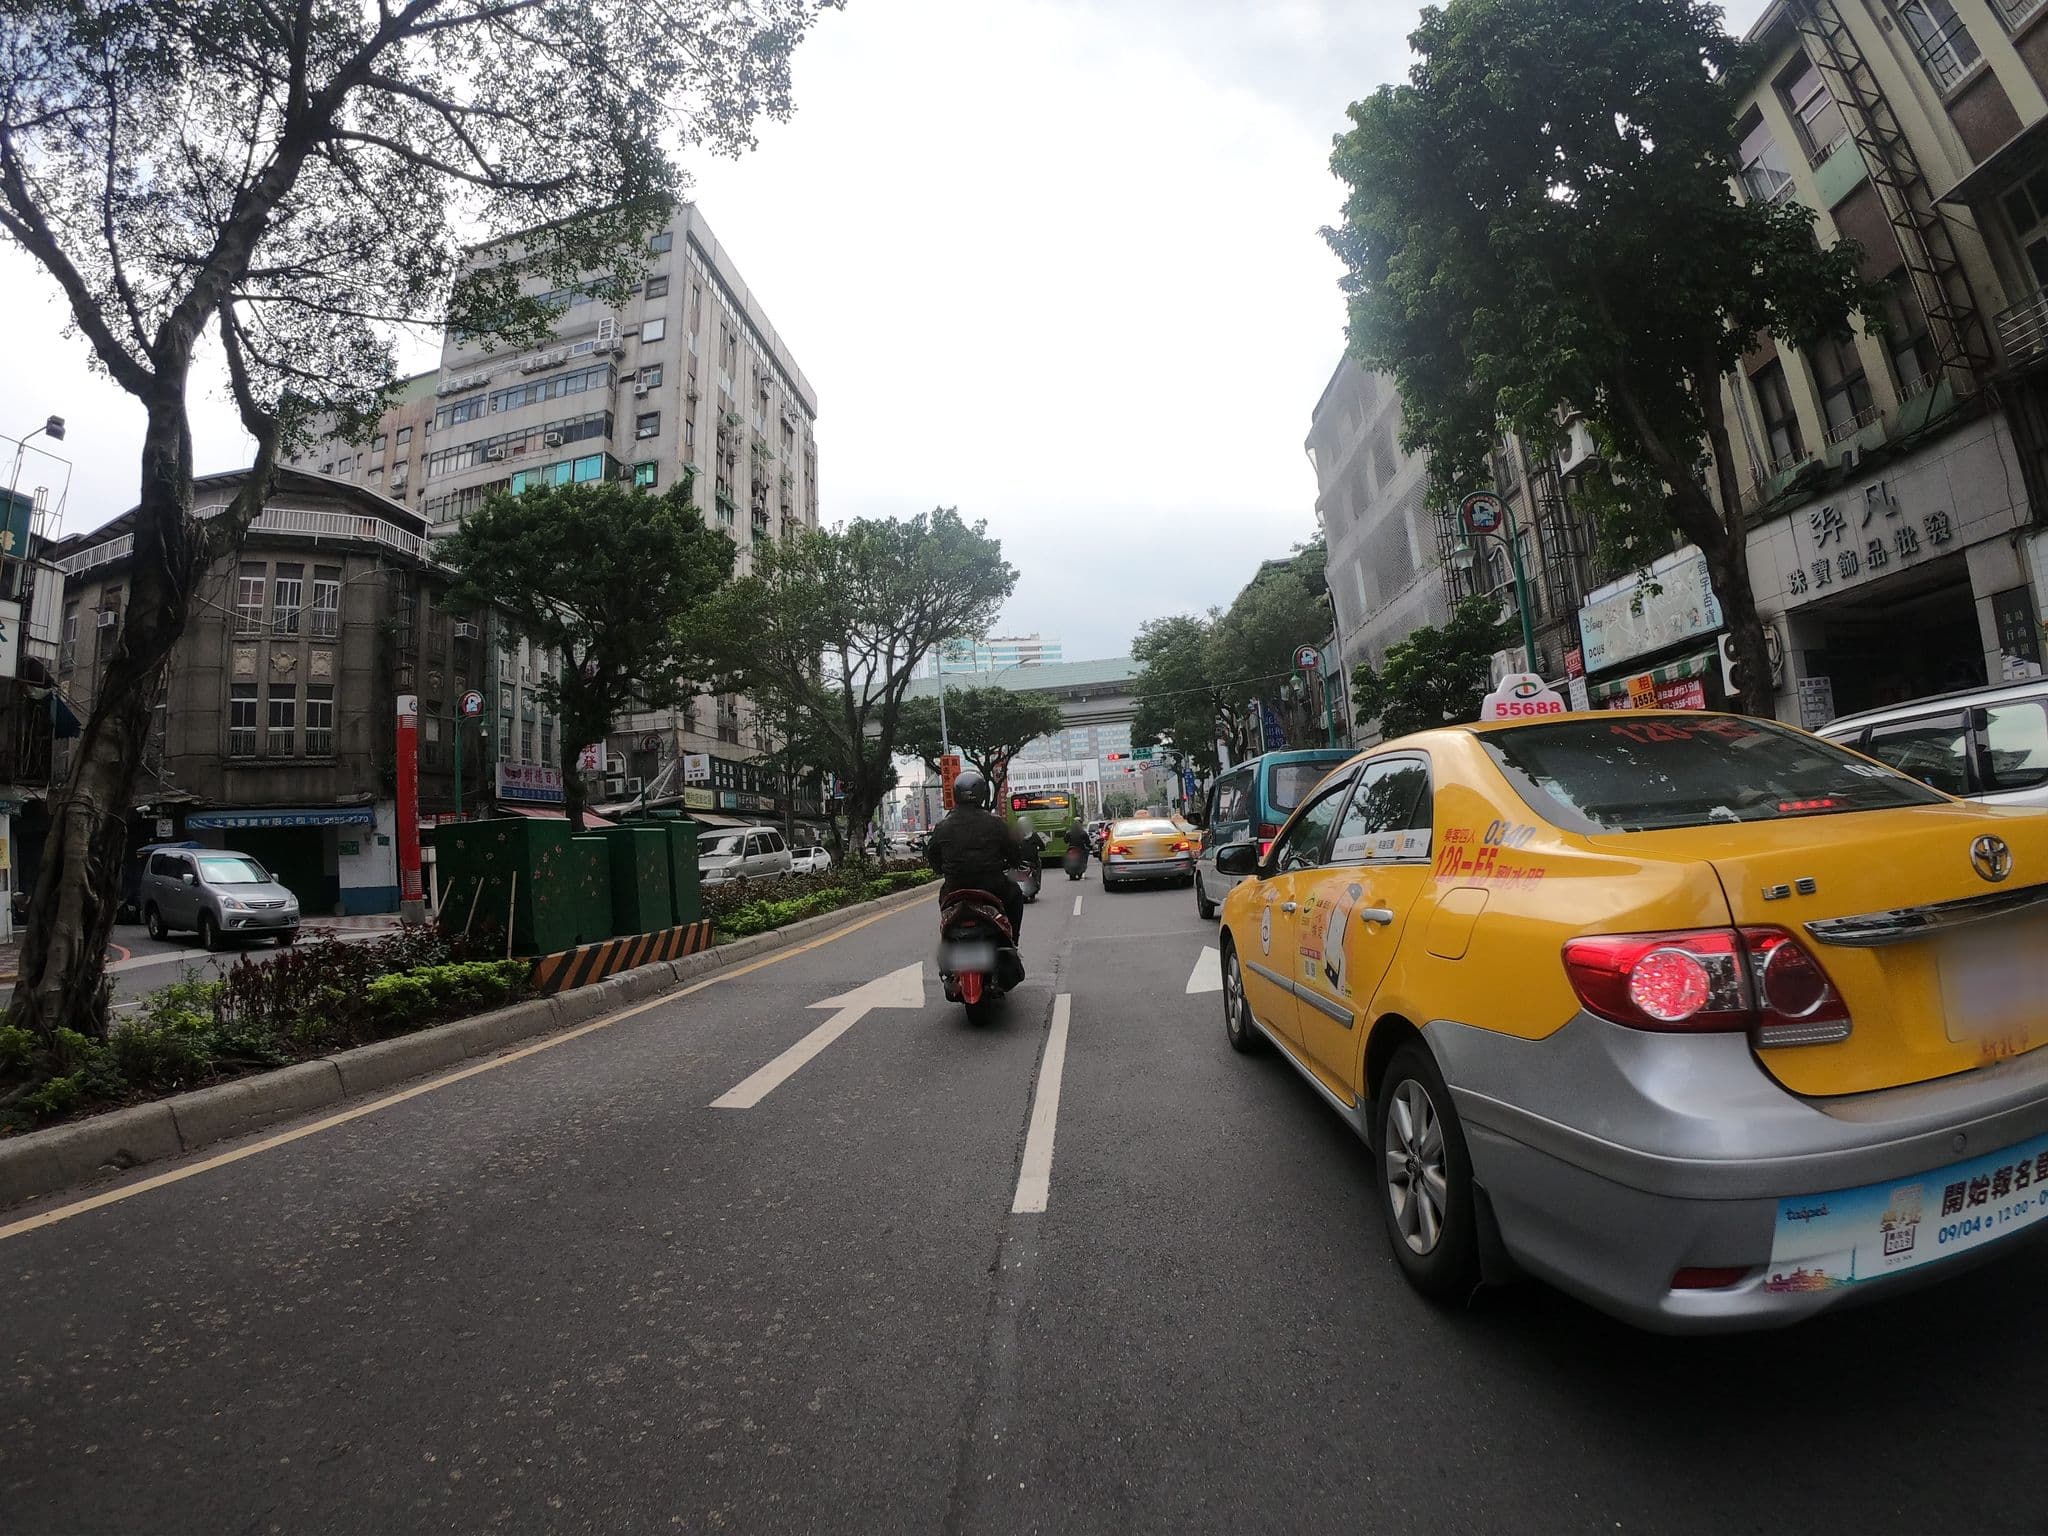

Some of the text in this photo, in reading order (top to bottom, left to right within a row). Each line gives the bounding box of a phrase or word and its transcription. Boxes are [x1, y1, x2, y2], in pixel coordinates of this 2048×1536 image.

[1786, 511, 1952, 595] 珠寶飾品批發
[1496, 702, 1562, 716] 55688
[1938, 1217, 1981, 1245] 09/04
